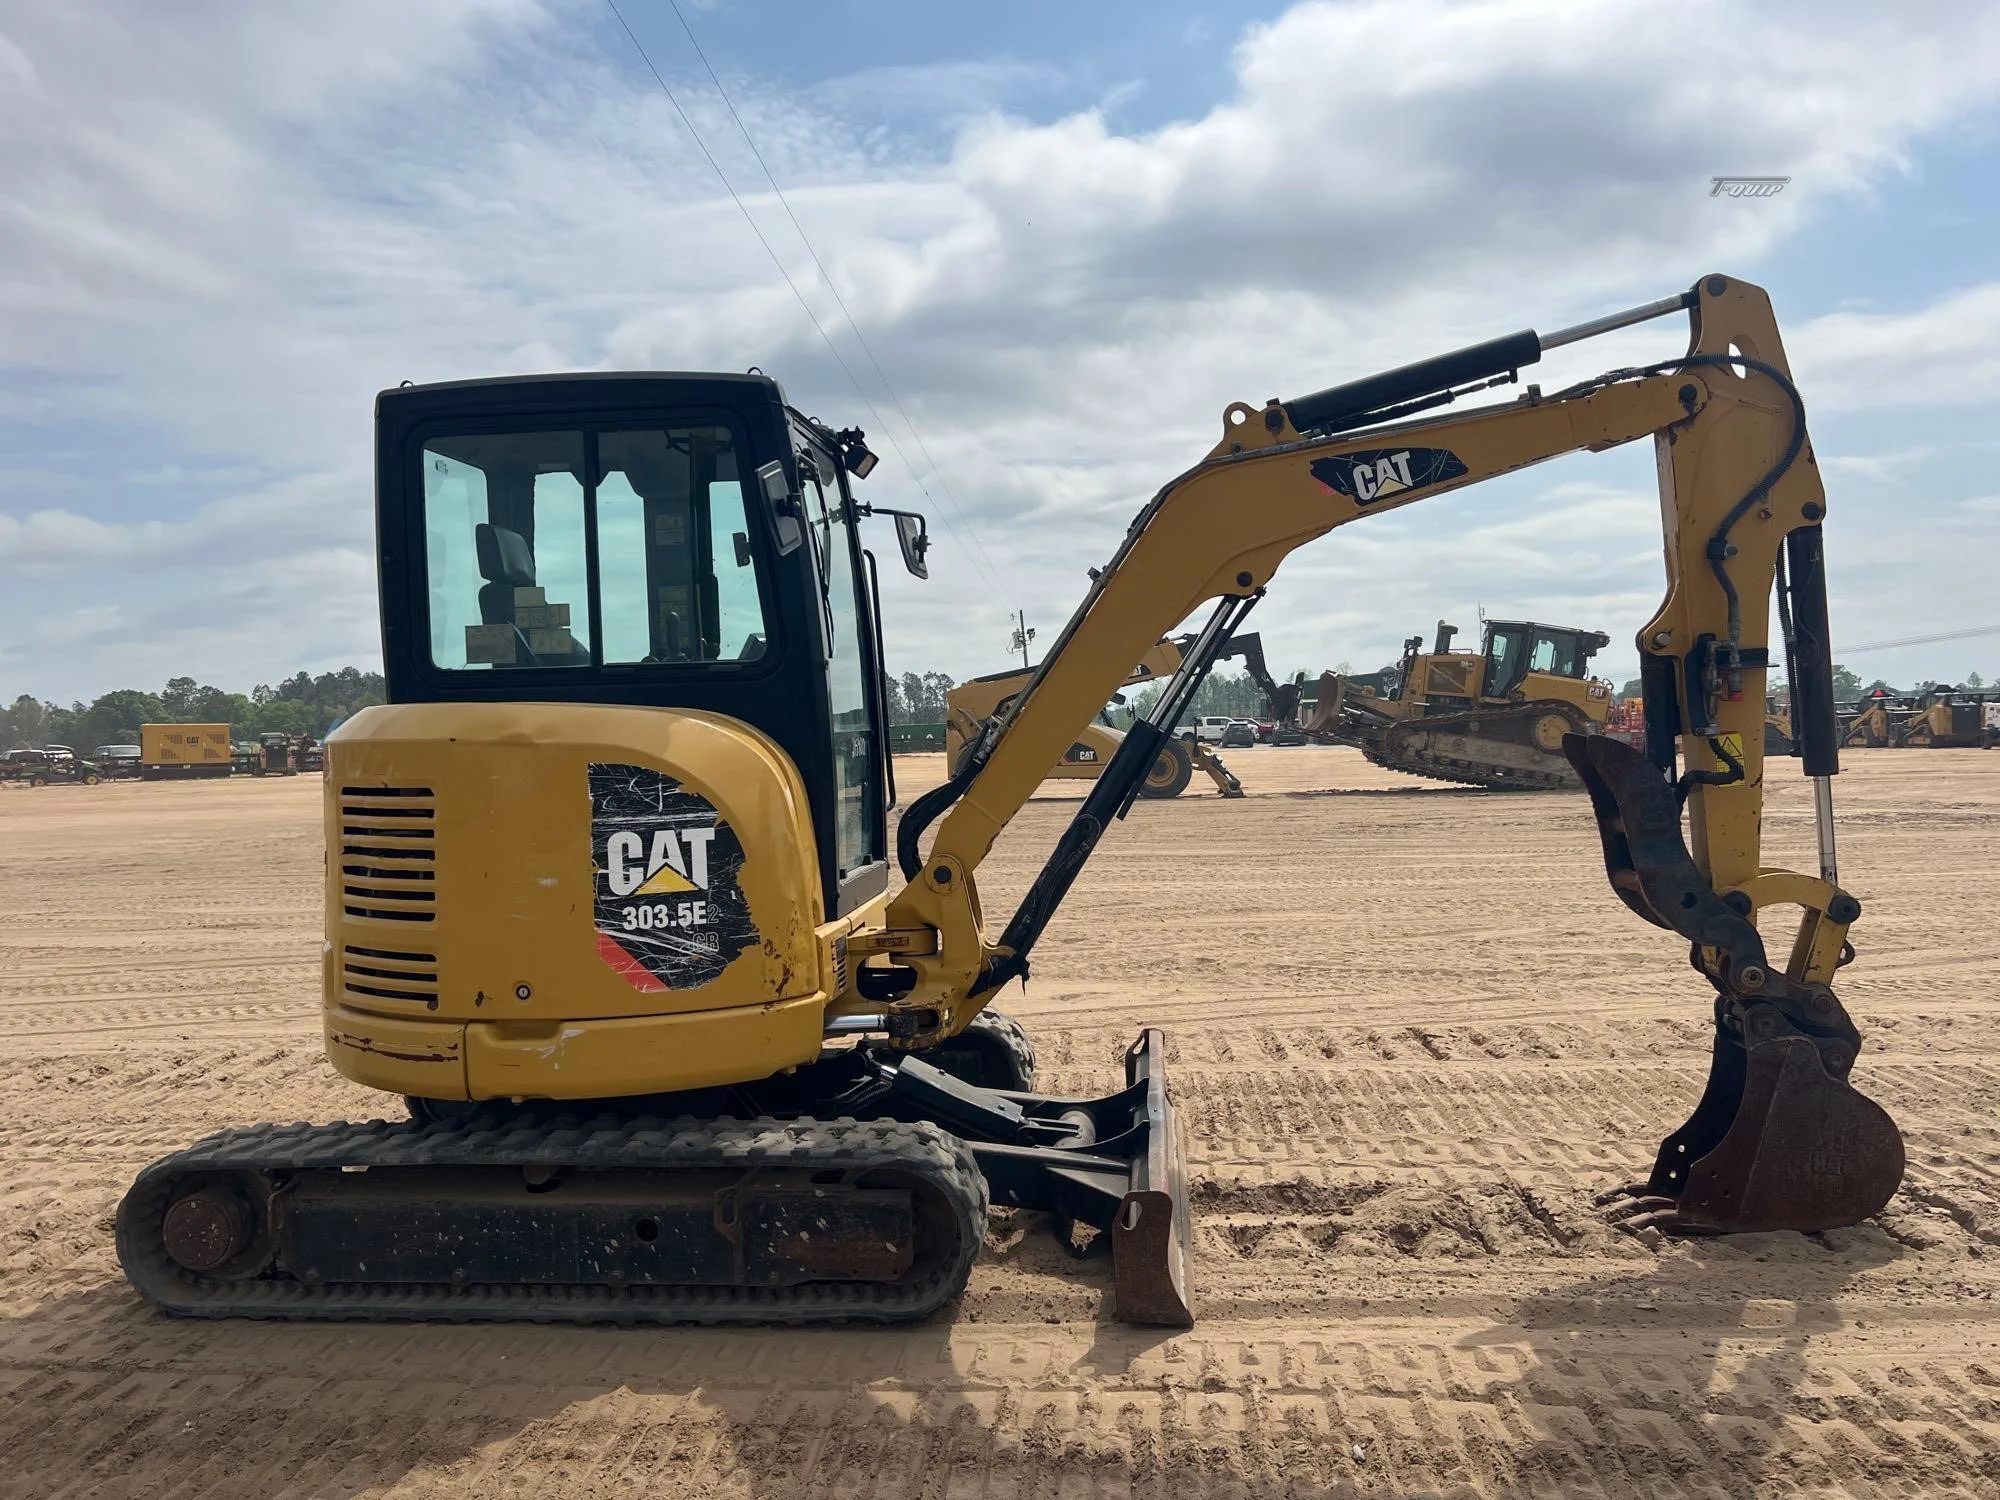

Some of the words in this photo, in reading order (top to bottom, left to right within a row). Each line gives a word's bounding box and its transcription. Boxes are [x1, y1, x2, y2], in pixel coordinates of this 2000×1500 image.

[1352, 451, 1413, 500] CAT
[1589, 687, 1604, 697] CAT
[186, 736, 200, 744] CAT
[1080, 751, 1094, 760] CAT
[607, 828, 715, 896] CAT
